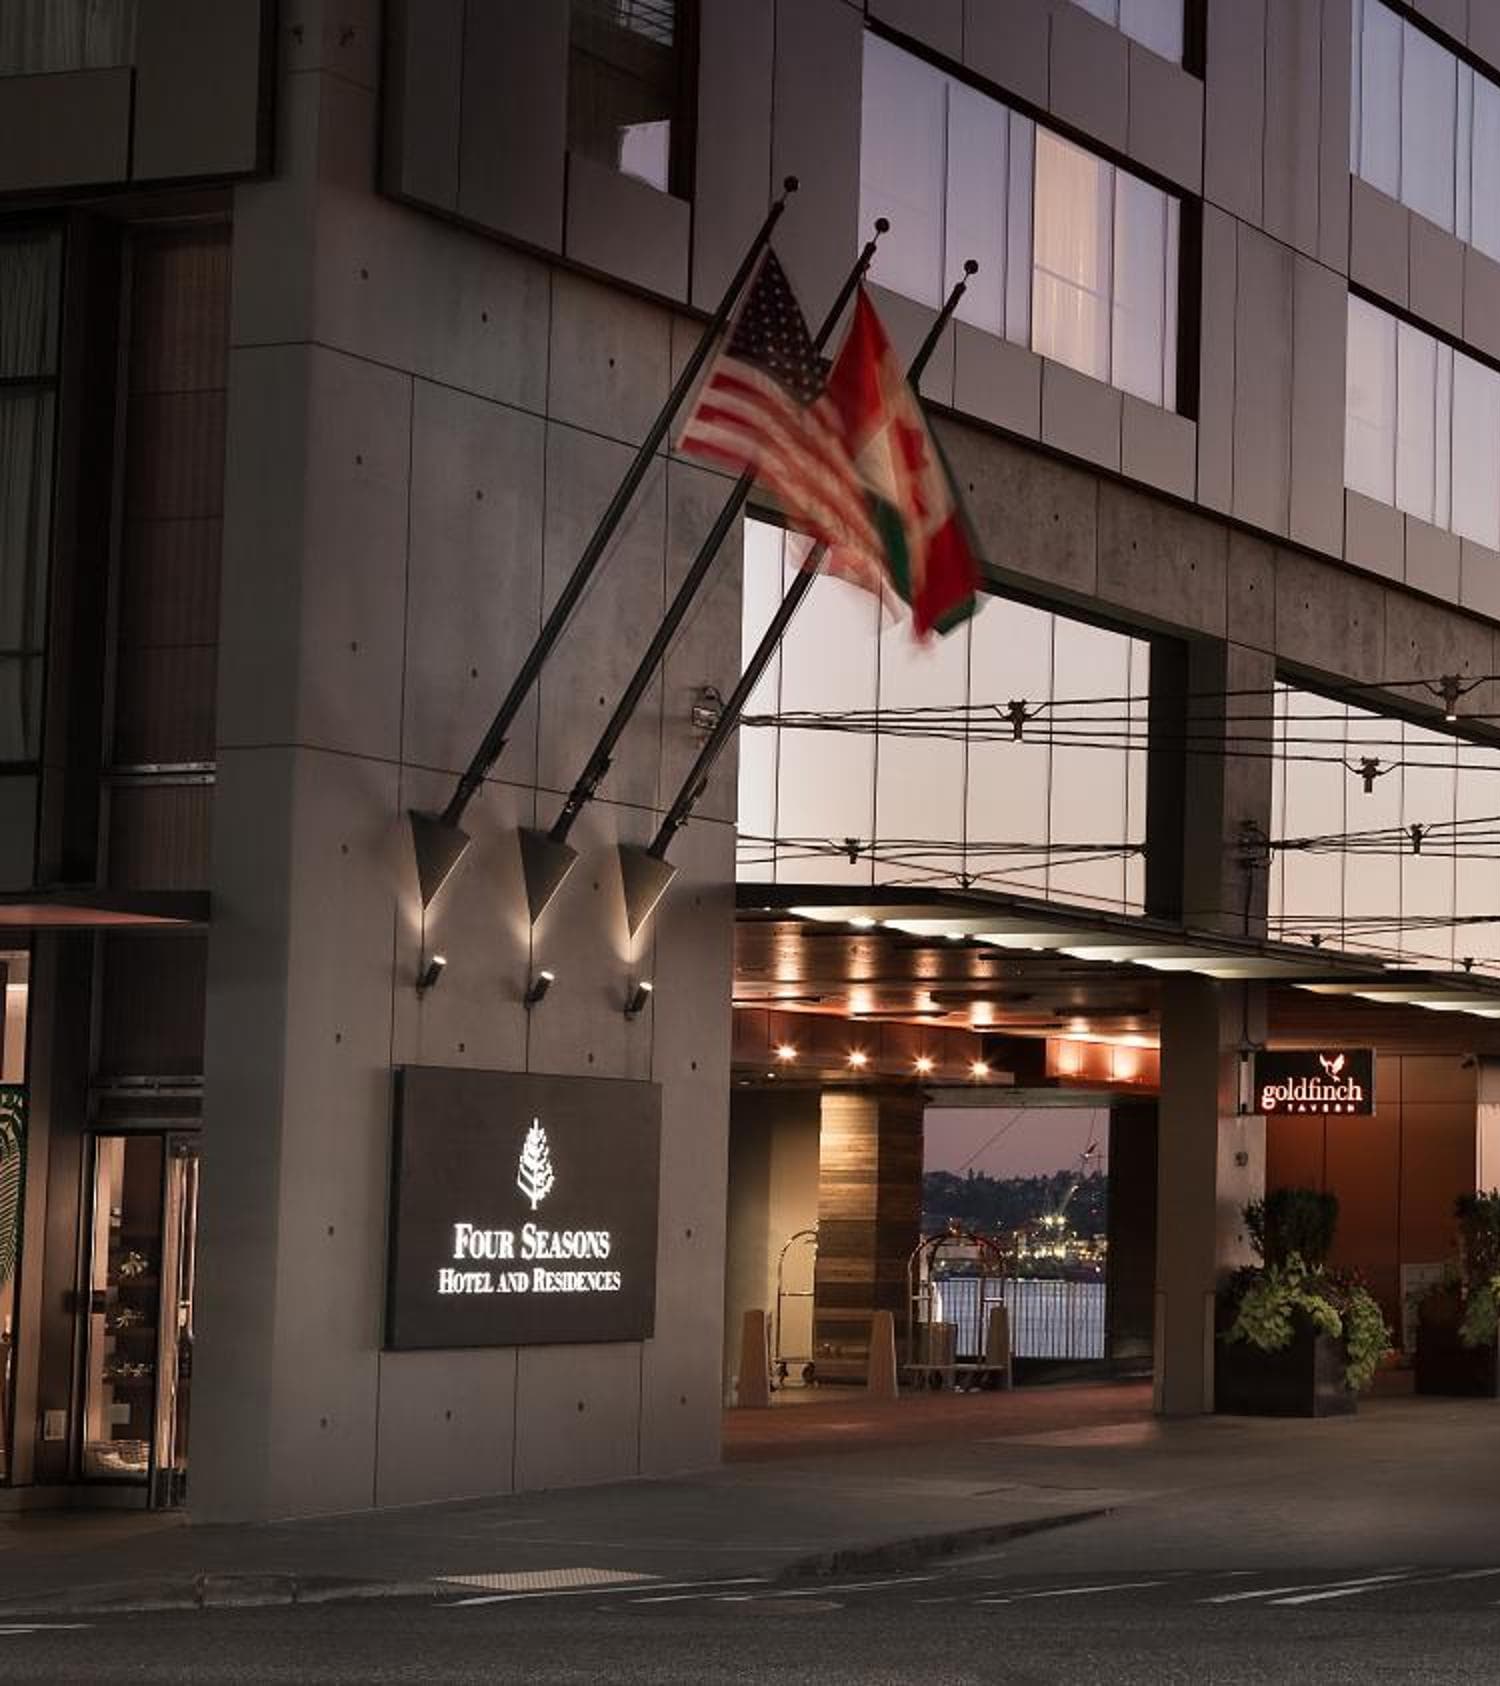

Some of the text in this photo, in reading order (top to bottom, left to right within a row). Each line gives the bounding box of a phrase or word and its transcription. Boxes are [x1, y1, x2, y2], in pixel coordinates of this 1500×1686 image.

[1261, 1077, 1363, 1110] goldfinch
[453, 1222, 610, 1260] FOUR SEASONS
[438, 1268, 621, 1294] HOTEL AND RESIDENCES
